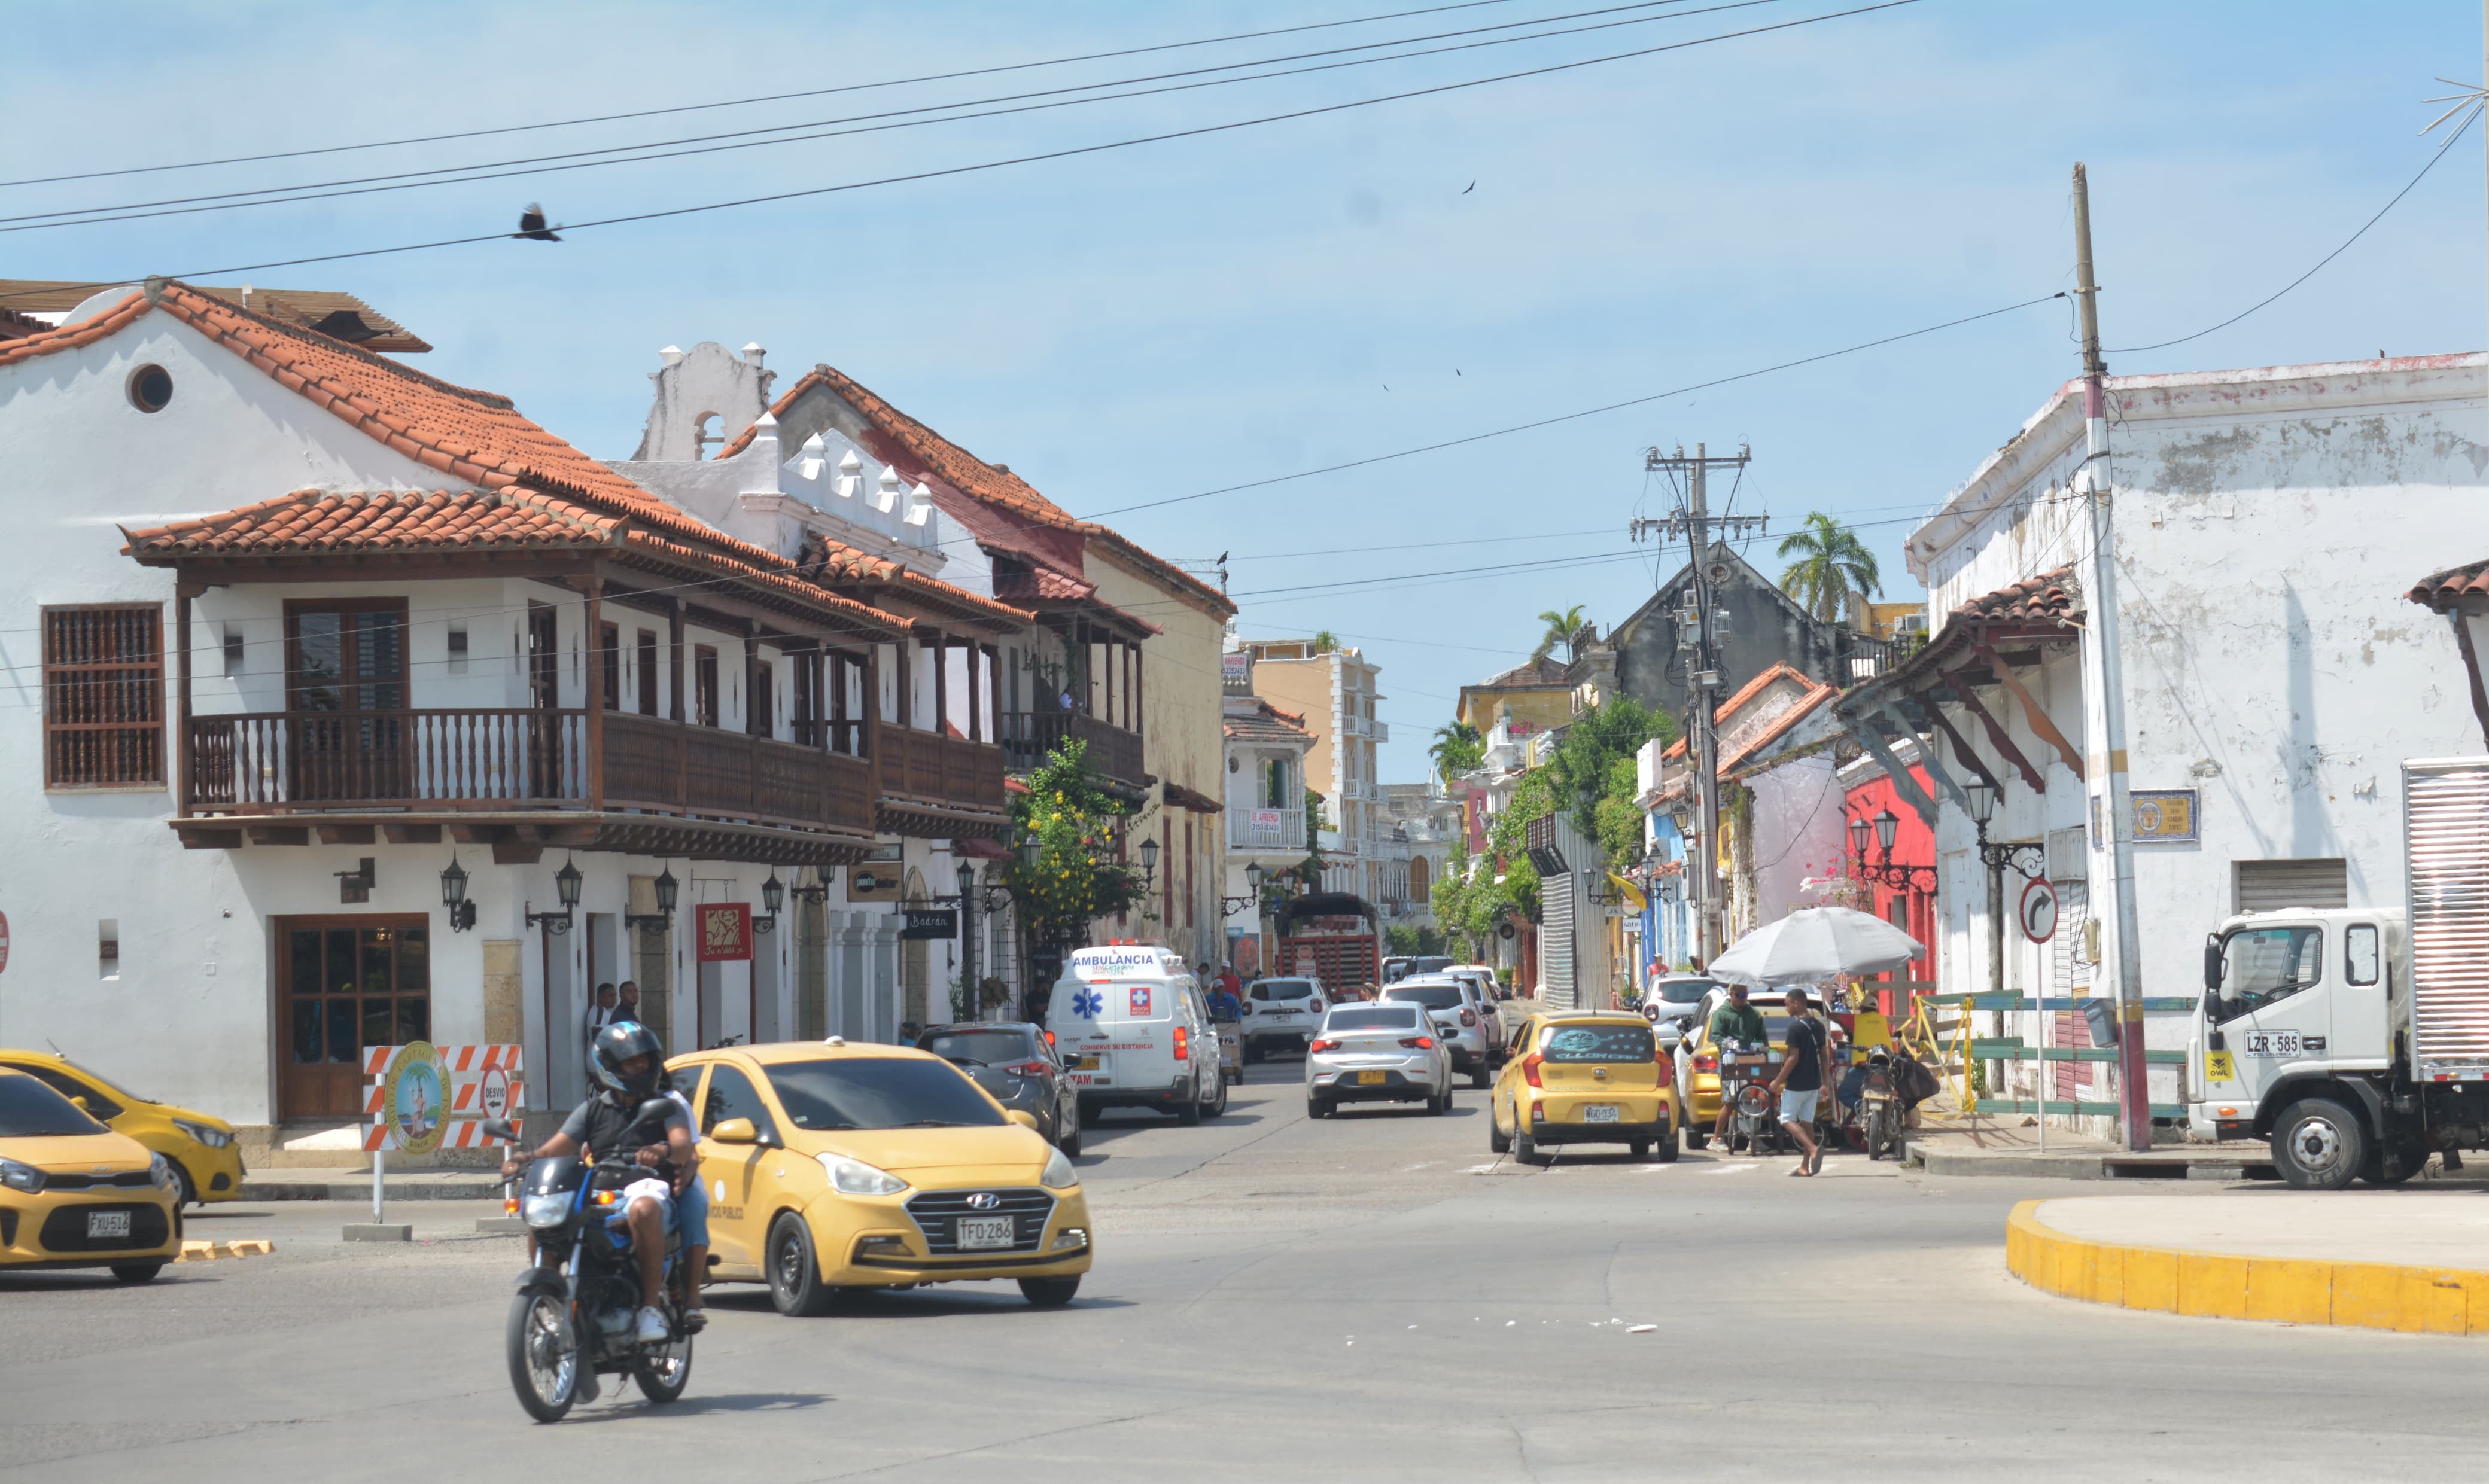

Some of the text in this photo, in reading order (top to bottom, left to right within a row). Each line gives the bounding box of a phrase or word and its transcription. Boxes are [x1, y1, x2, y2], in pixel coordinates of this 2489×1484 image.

[1252, 812, 1257, 821] SE
[856, 877, 875, 886] punto
[1073, 955, 1154, 967] AMBULANCIA
[2247, 1035, 2298, 1052] LZR 585
[397, 1049, 442, 1075] CARTAGENA
[486, 1087, 505, 1098] DESVIO
